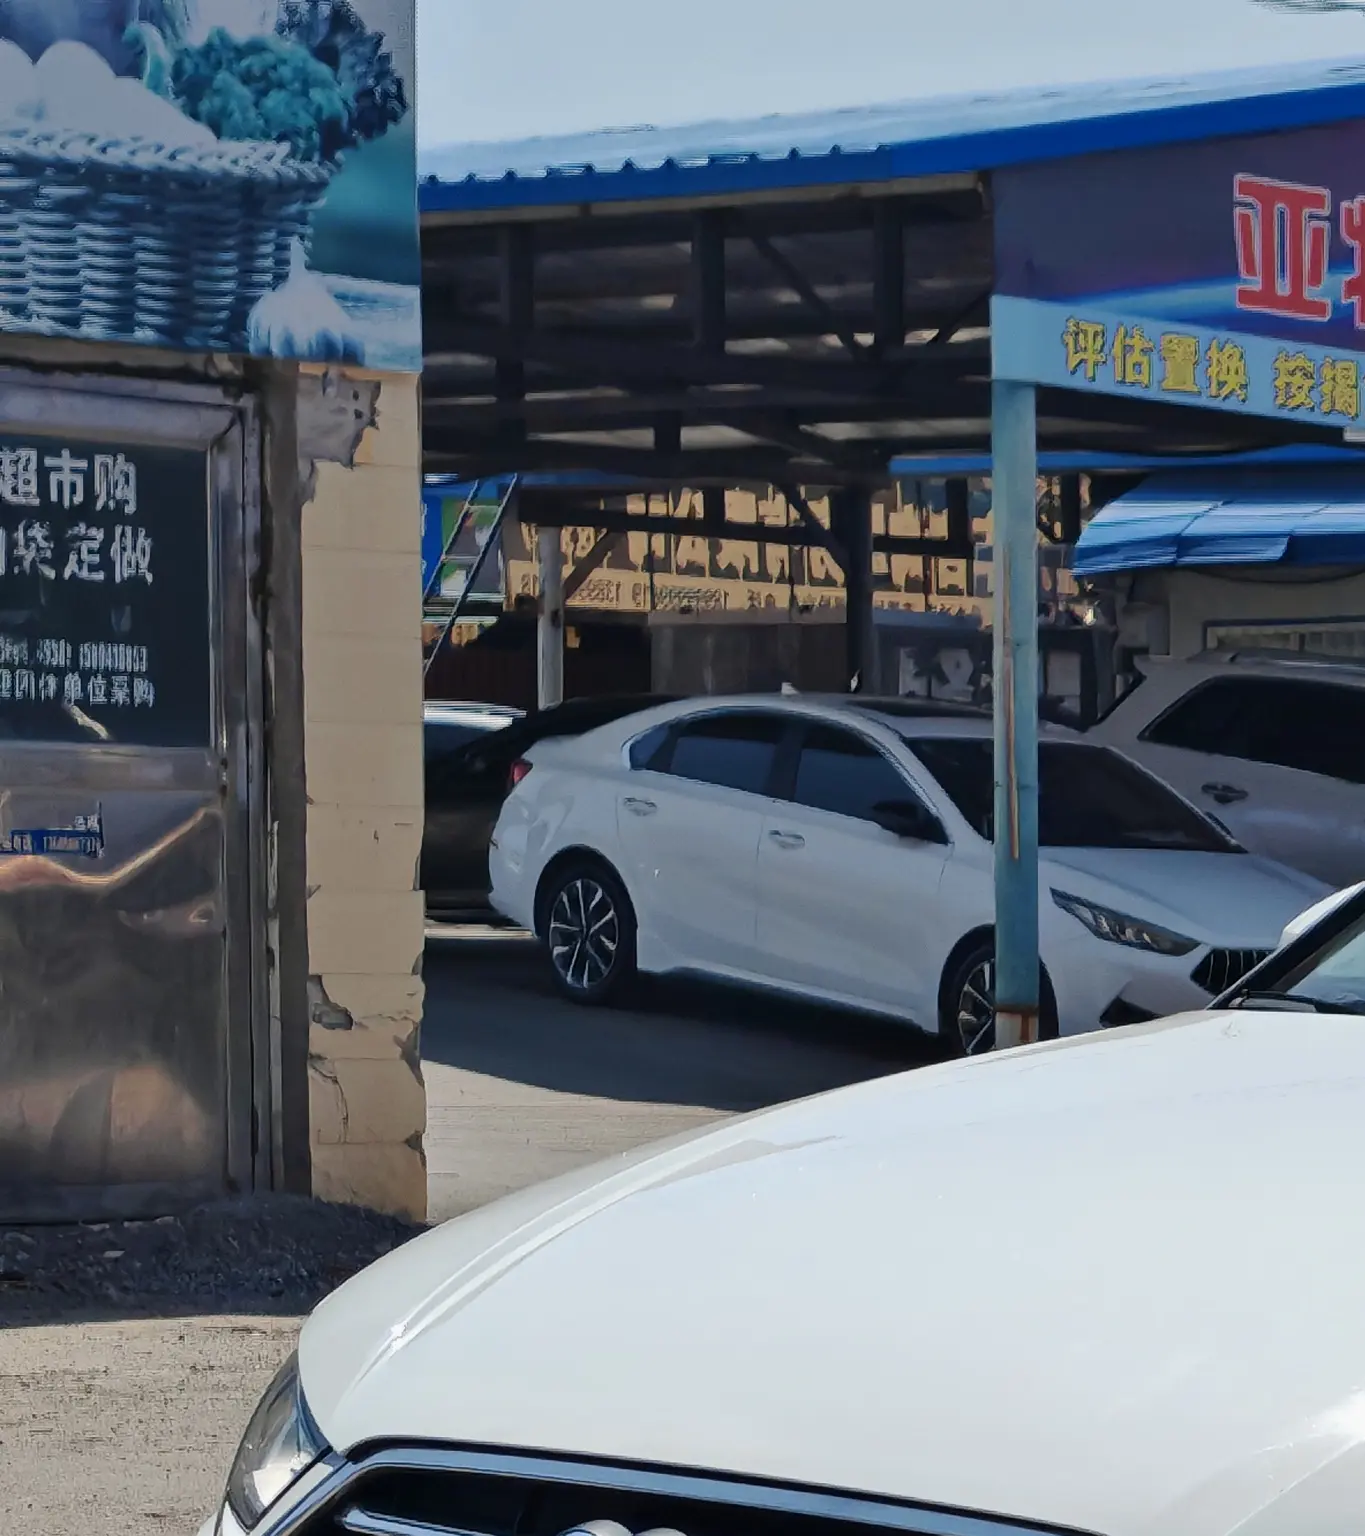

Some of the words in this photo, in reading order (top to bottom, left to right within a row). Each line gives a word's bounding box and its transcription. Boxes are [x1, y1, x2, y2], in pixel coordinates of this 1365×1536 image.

[1062, 314, 1250, 403] 评估置换
[0, 519, 153, 585] 袋定做
